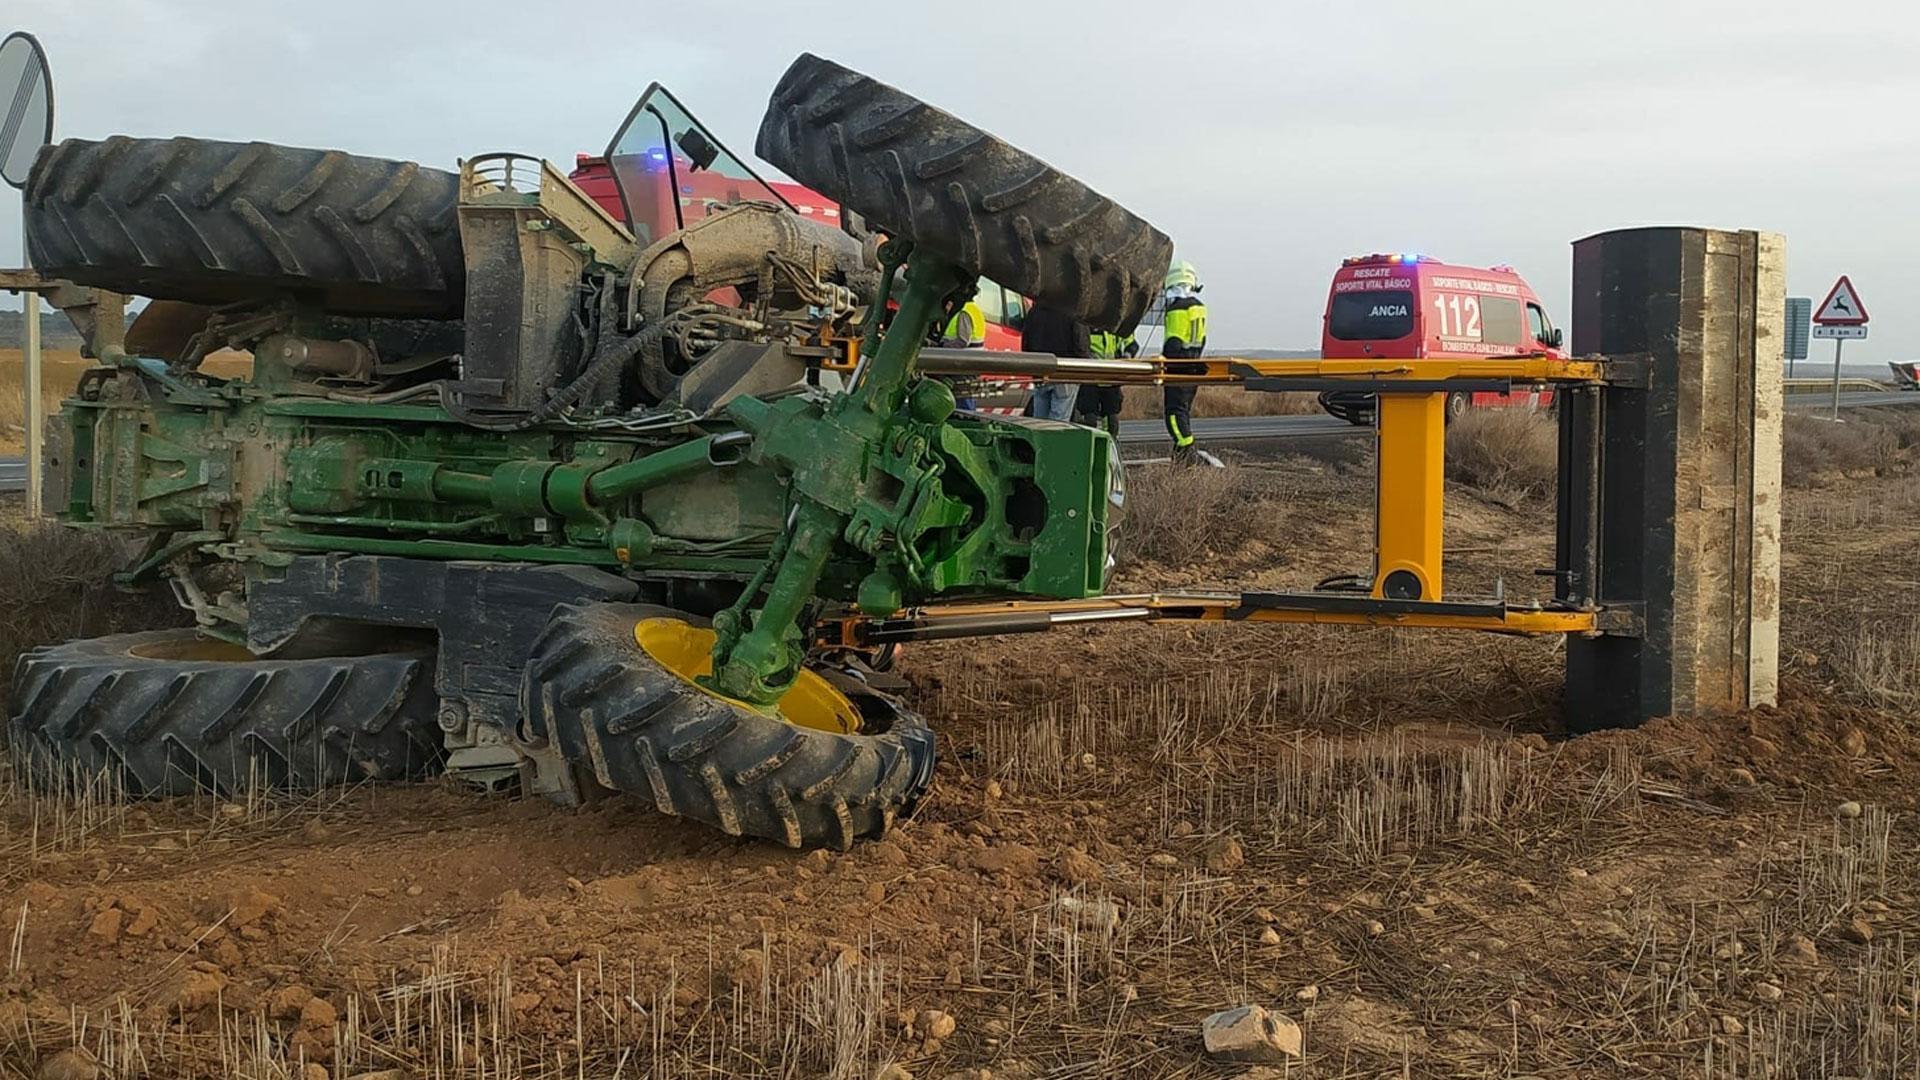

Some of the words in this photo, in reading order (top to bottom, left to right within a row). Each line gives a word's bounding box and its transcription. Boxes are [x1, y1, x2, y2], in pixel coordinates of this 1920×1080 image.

[1354, 268, 1391, 278] RESCATE
[1336, 281, 1365, 292] SOPORTE
[1366, 279, 1383, 290] VITAL
[1368, 304, 1408, 317] ANCIA
[1434, 294, 1482, 336] 112
